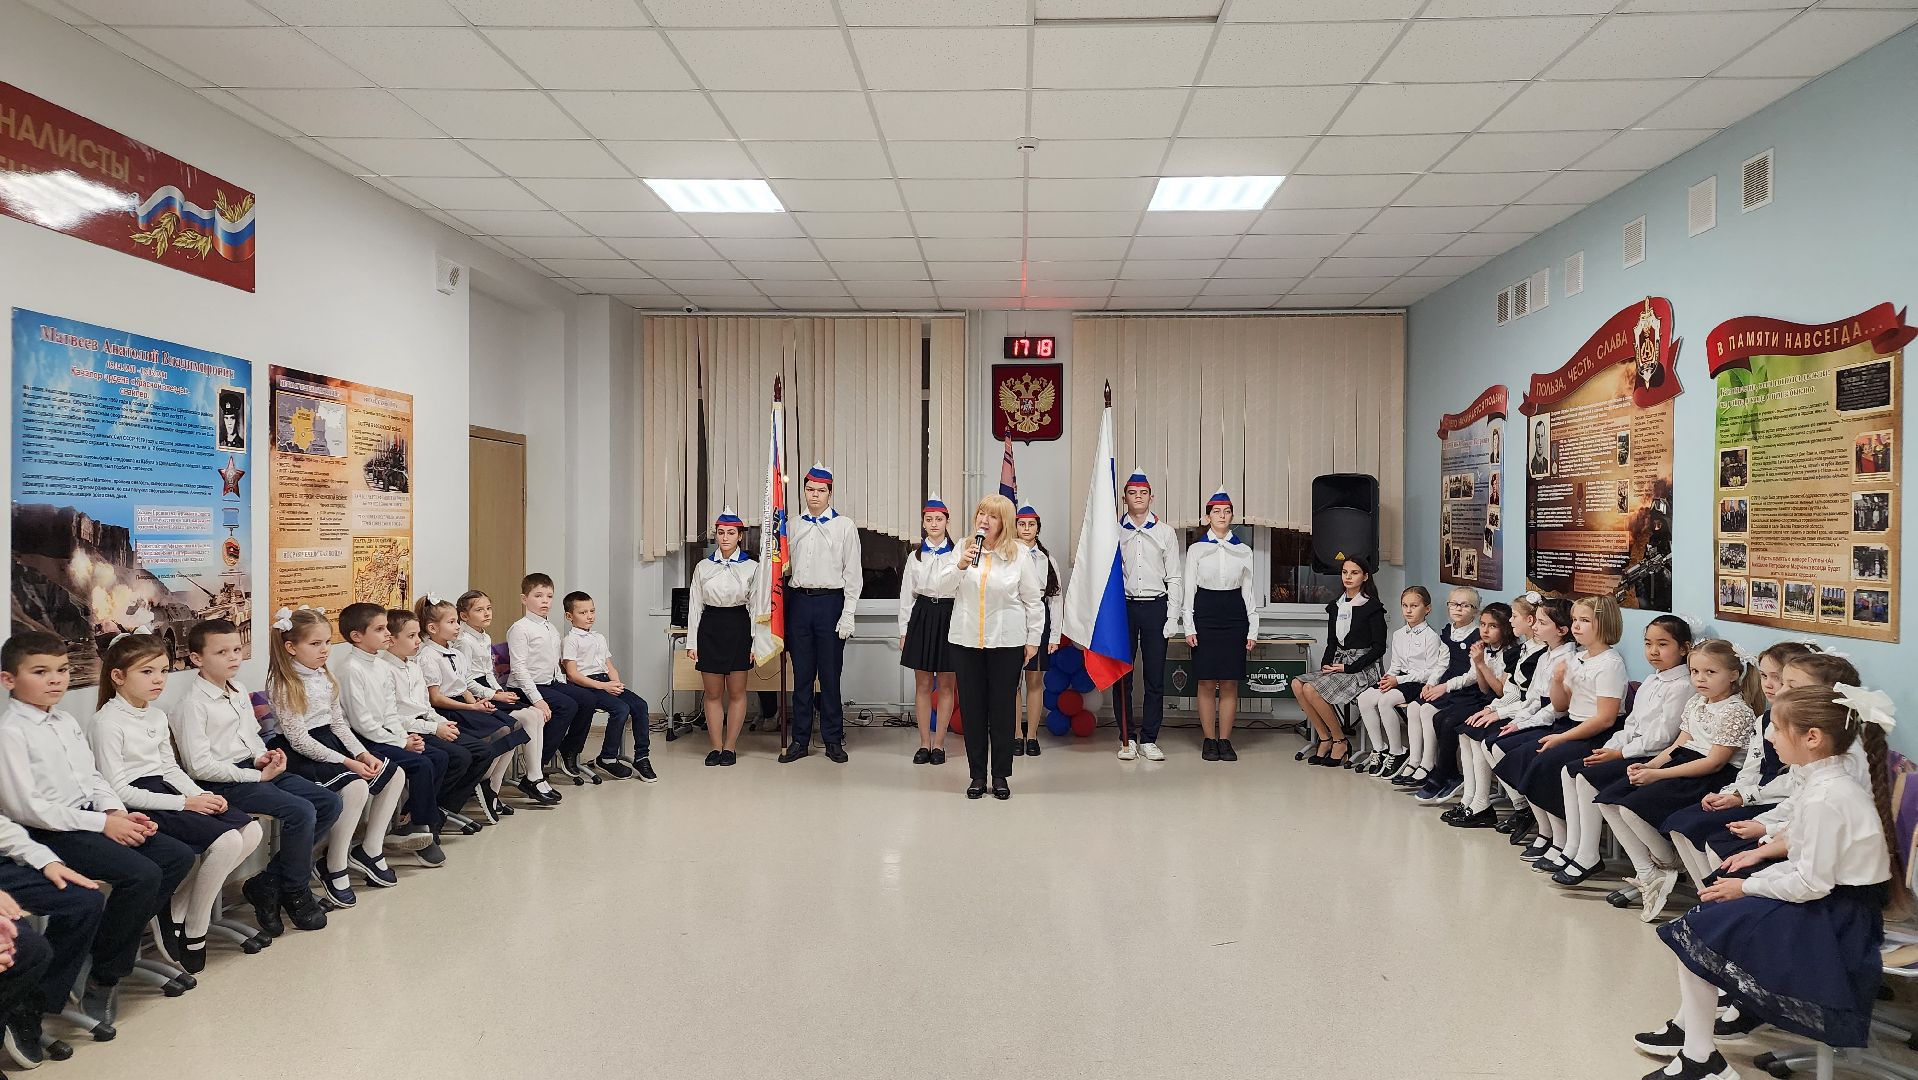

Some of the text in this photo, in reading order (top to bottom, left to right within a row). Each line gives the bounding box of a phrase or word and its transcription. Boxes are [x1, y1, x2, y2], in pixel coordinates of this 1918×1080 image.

[40, 325, 235, 379] Матвеев Анатолий Владимирович
[1536, 329, 1628, 397] ПОЛЬЗА, ЧЕСТЬ, СЛАВА
[1717, 321, 1883, 356] В ПАМЯТИ НАВСЕГДА...
